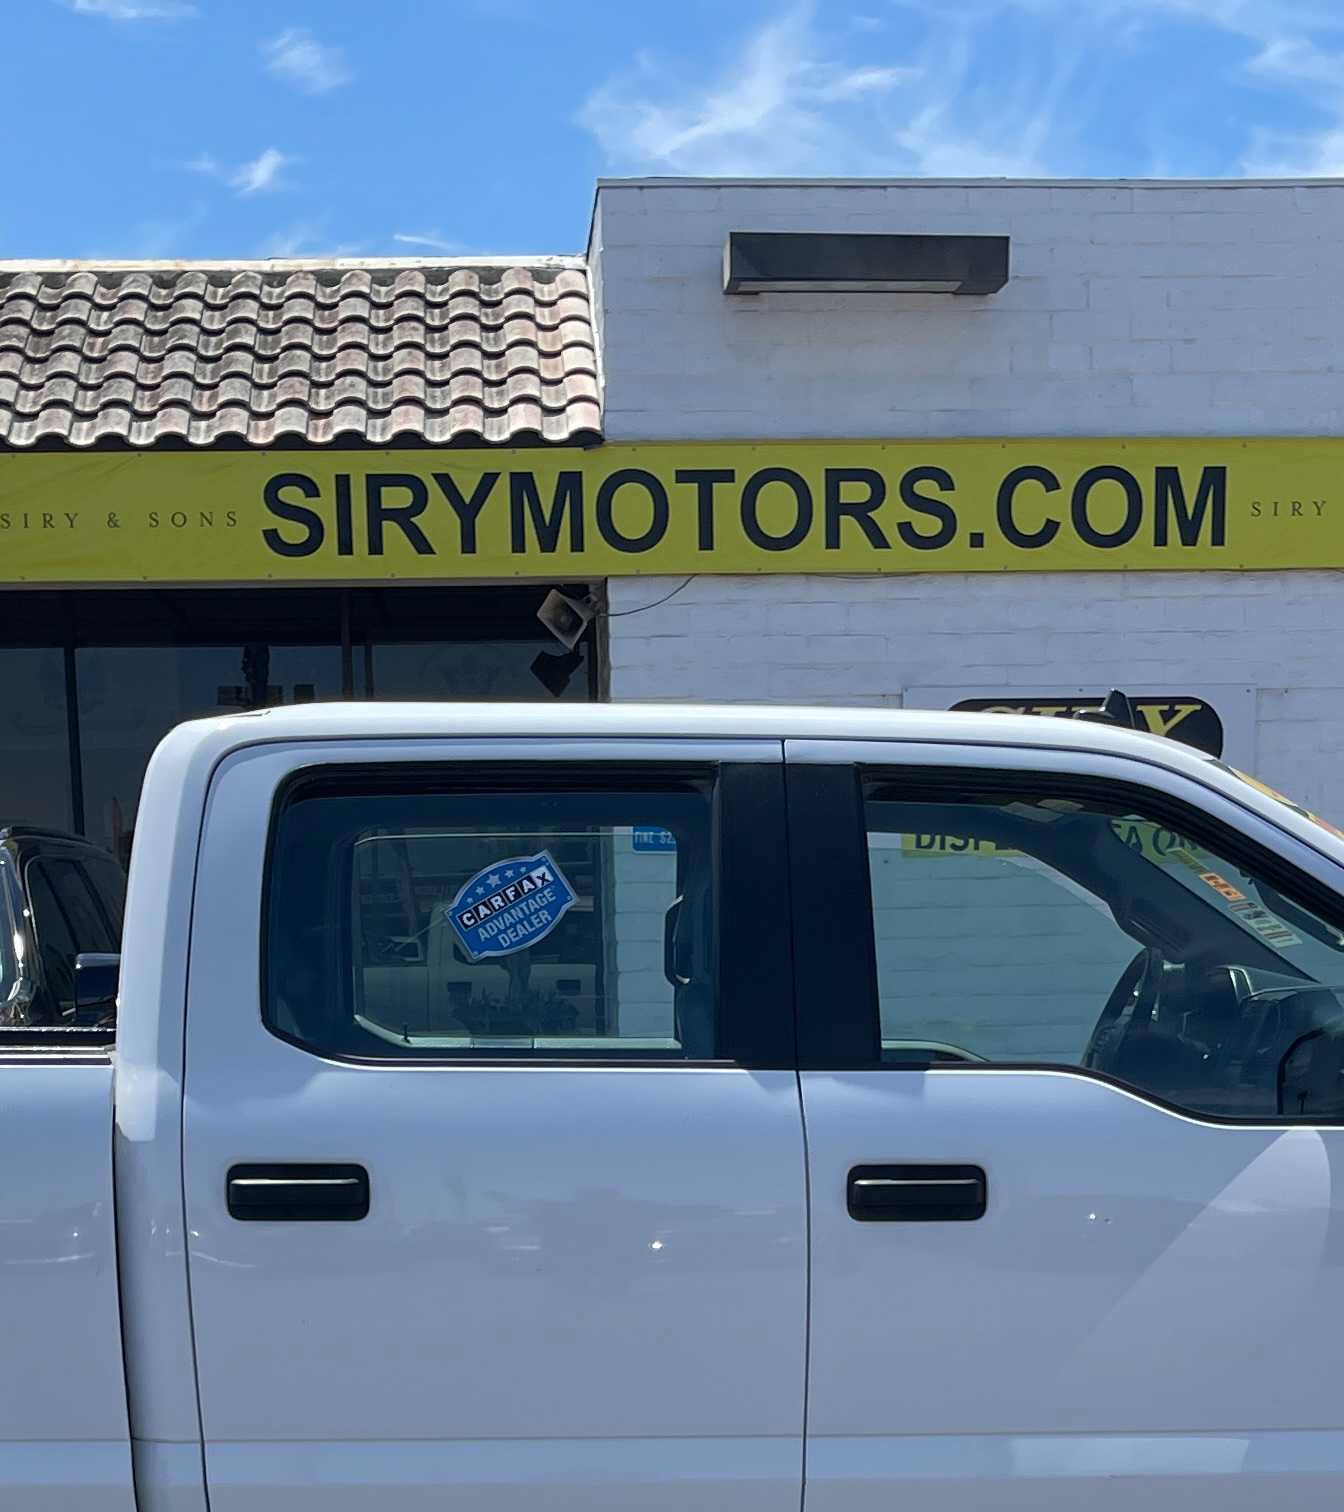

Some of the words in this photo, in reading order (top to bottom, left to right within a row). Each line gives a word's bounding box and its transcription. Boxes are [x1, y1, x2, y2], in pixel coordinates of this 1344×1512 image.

[0, 512, 80, 530] SIRY
[106, 512, 120, 529] &
[148, 510, 239, 529] SONS
[261, 465, 1230, 558] SIRYMOTORS.COM
[1250, 499, 1328, 518] SIRY
[460, 869, 552, 928] CARFAX
[476, 887, 556, 942] ADVANTAGE
[497, 909, 553, 948] DEALER
